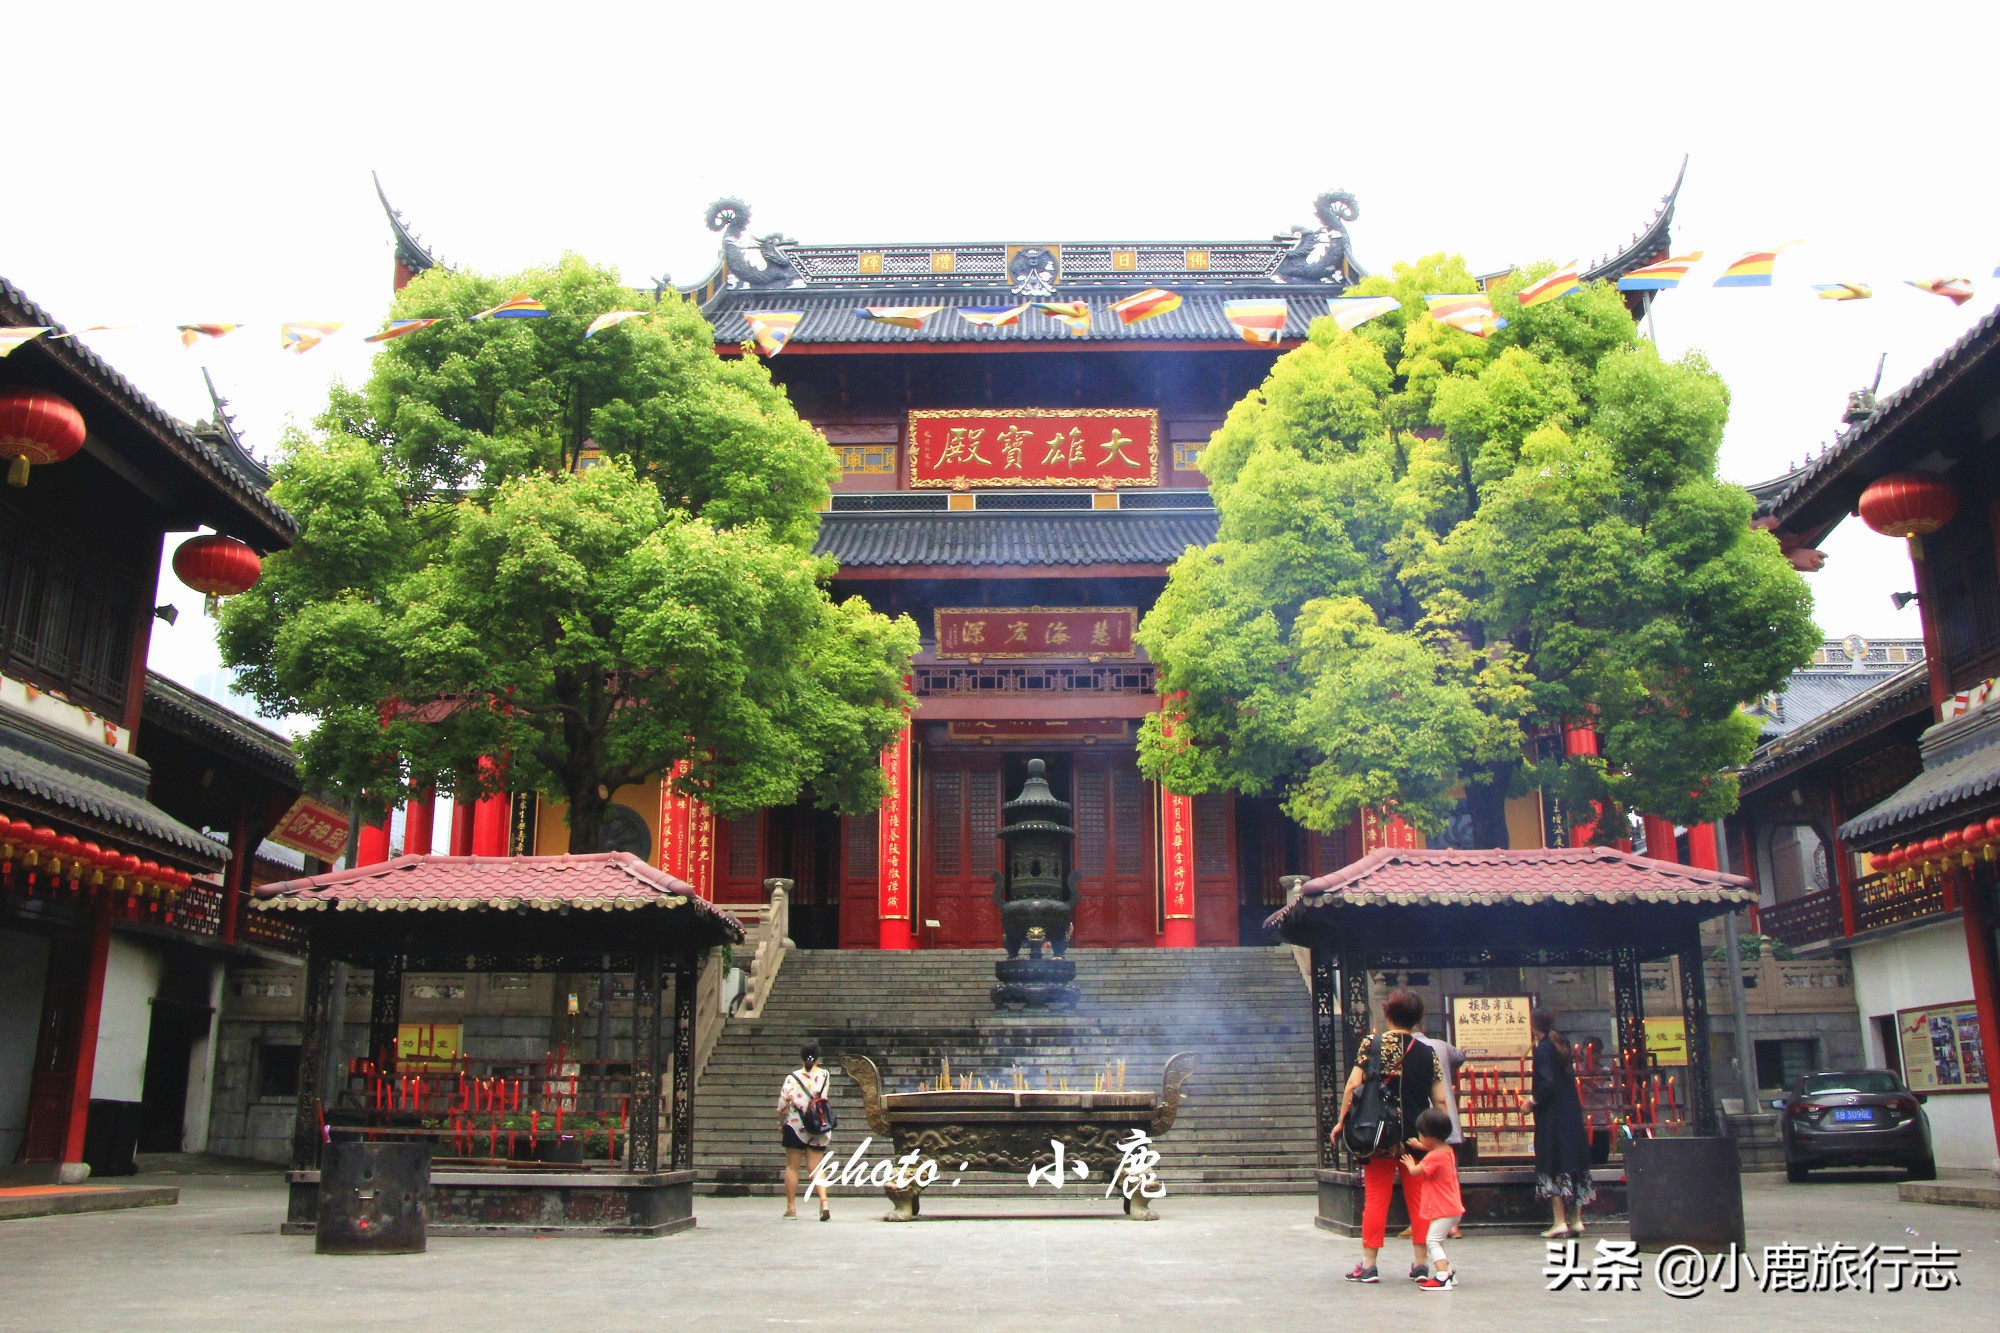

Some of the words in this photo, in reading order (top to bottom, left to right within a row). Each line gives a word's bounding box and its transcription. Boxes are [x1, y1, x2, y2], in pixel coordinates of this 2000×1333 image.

[933, 425, 1141, 470] 大雄寶殿
[288, 812, 348, 849] 财神殿
